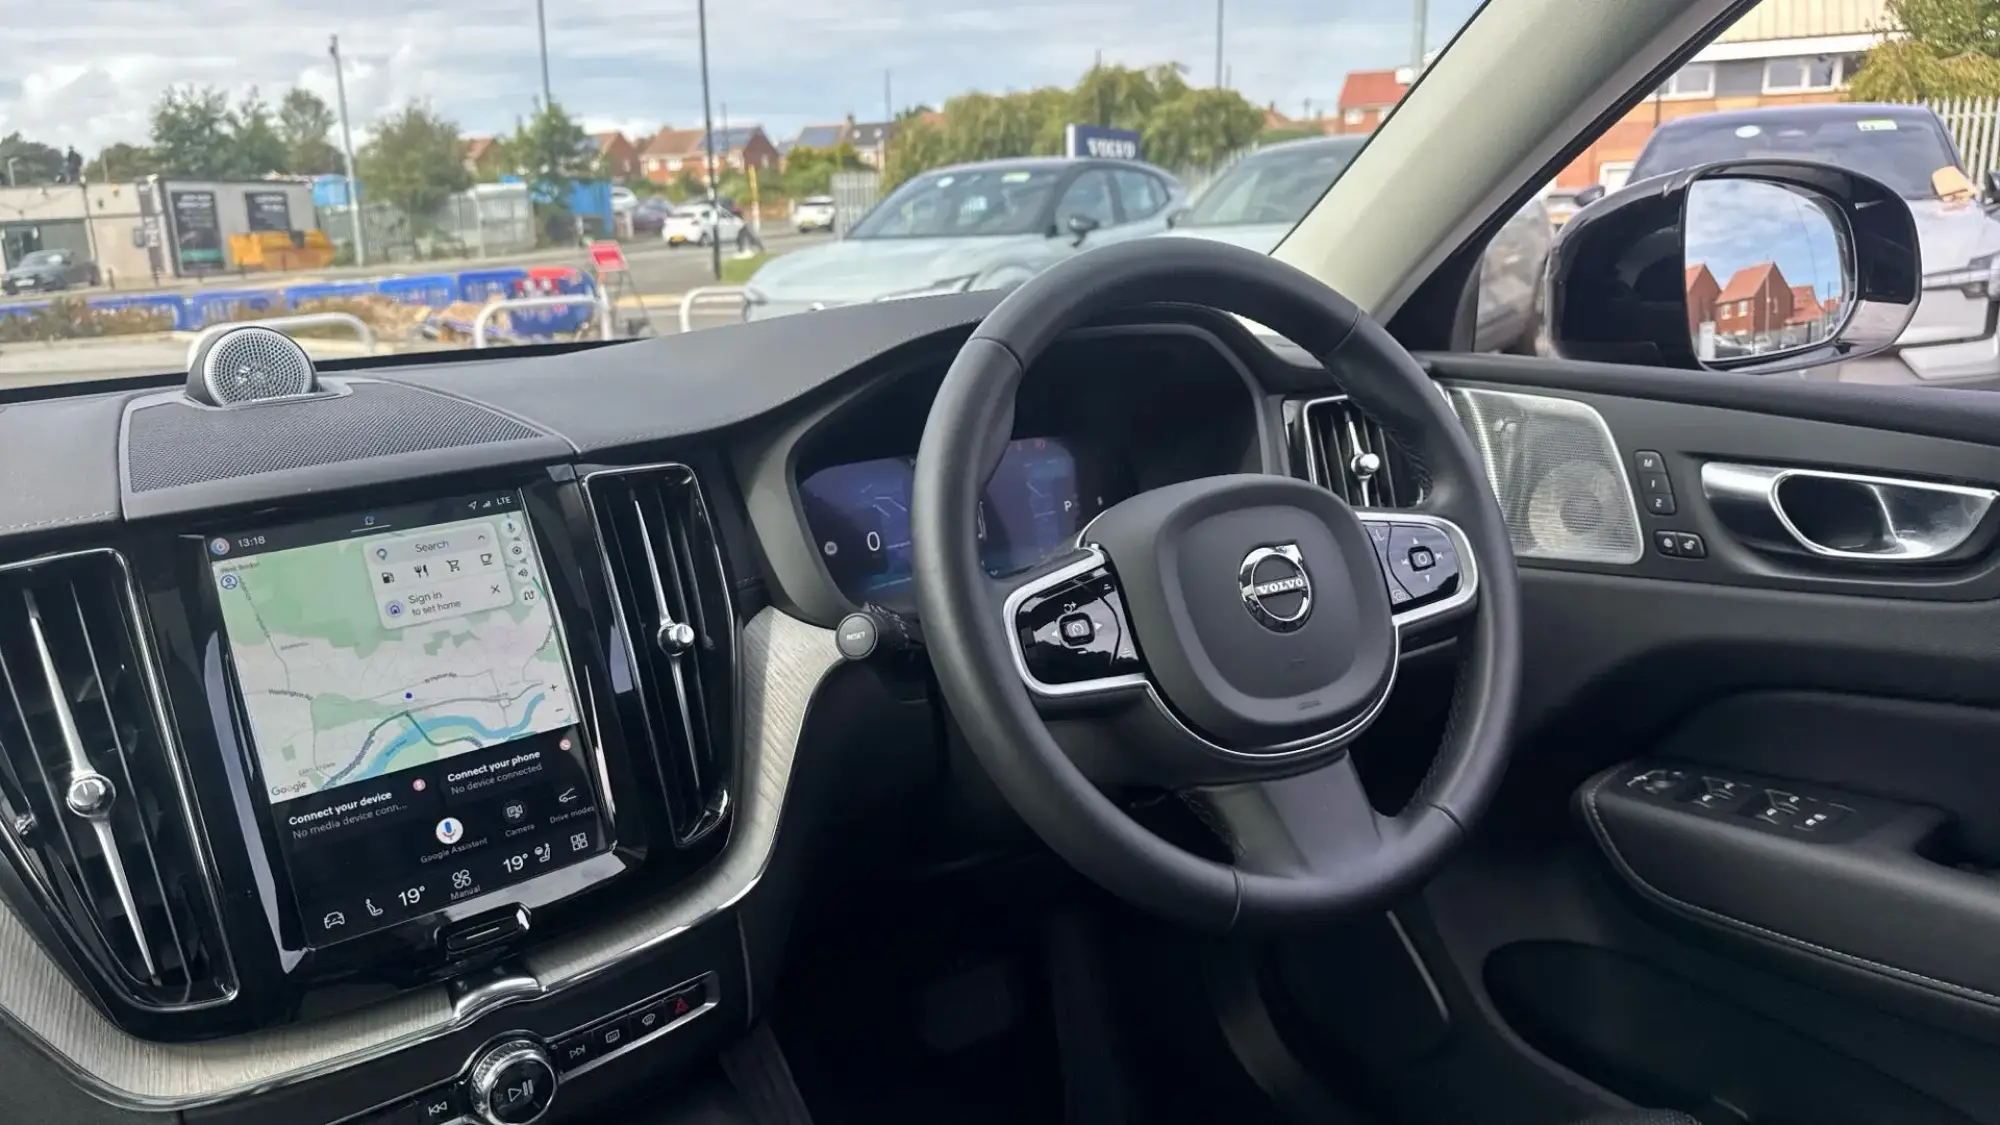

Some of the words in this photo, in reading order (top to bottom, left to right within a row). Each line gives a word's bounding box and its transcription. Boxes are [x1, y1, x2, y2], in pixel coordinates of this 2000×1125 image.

[1643, 459, 1653, 468] M
[496, 496, 512, 506] LTE
[1063, 500, 1073, 512] P
[1655, 498, 1663, 508] 2
[238, 535, 266, 549] 13:18
[415, 539, 449, 553] Search
[866, 531, 881, 552] 0
[1257, 577, 1304, 595] VOLVO
[407, 593, 432, 606] Sign
[432, 591, 443, 600] in
[411, 607, 421, 616] to
[422, 604, 436, 615] set
[438, 600, 461, 612] home
[447, 766, 488, 782] Connect
[488, 759, 510, 773] your
[511, 751, 541, 767] phone
[451, 784, 466, 796] No
[467, 777, 495, 791] device
[497, 763, 543, 783] connected
[271, 780, 307, 796] Google
[288, 806, 334, 826] Connect
[334, 801, 358, 815] your
[359, 791, 393, 807] device
[549, 813, 569, 824] Drive
[570, 805, 596, 818] modes
[292, 828, 309, 840] No
[309, 819, 341, 835] media
[343, 810, 374, 826] device
[505, 823, 536, 838] Camera
[420, 850, 450, 864] Google
[451, 837, 488, 854] Assistant
[503, 853, 529, 873] 19°
[398, 885, 426, 907] 19°
[450, 885, 481, 901] Manual
